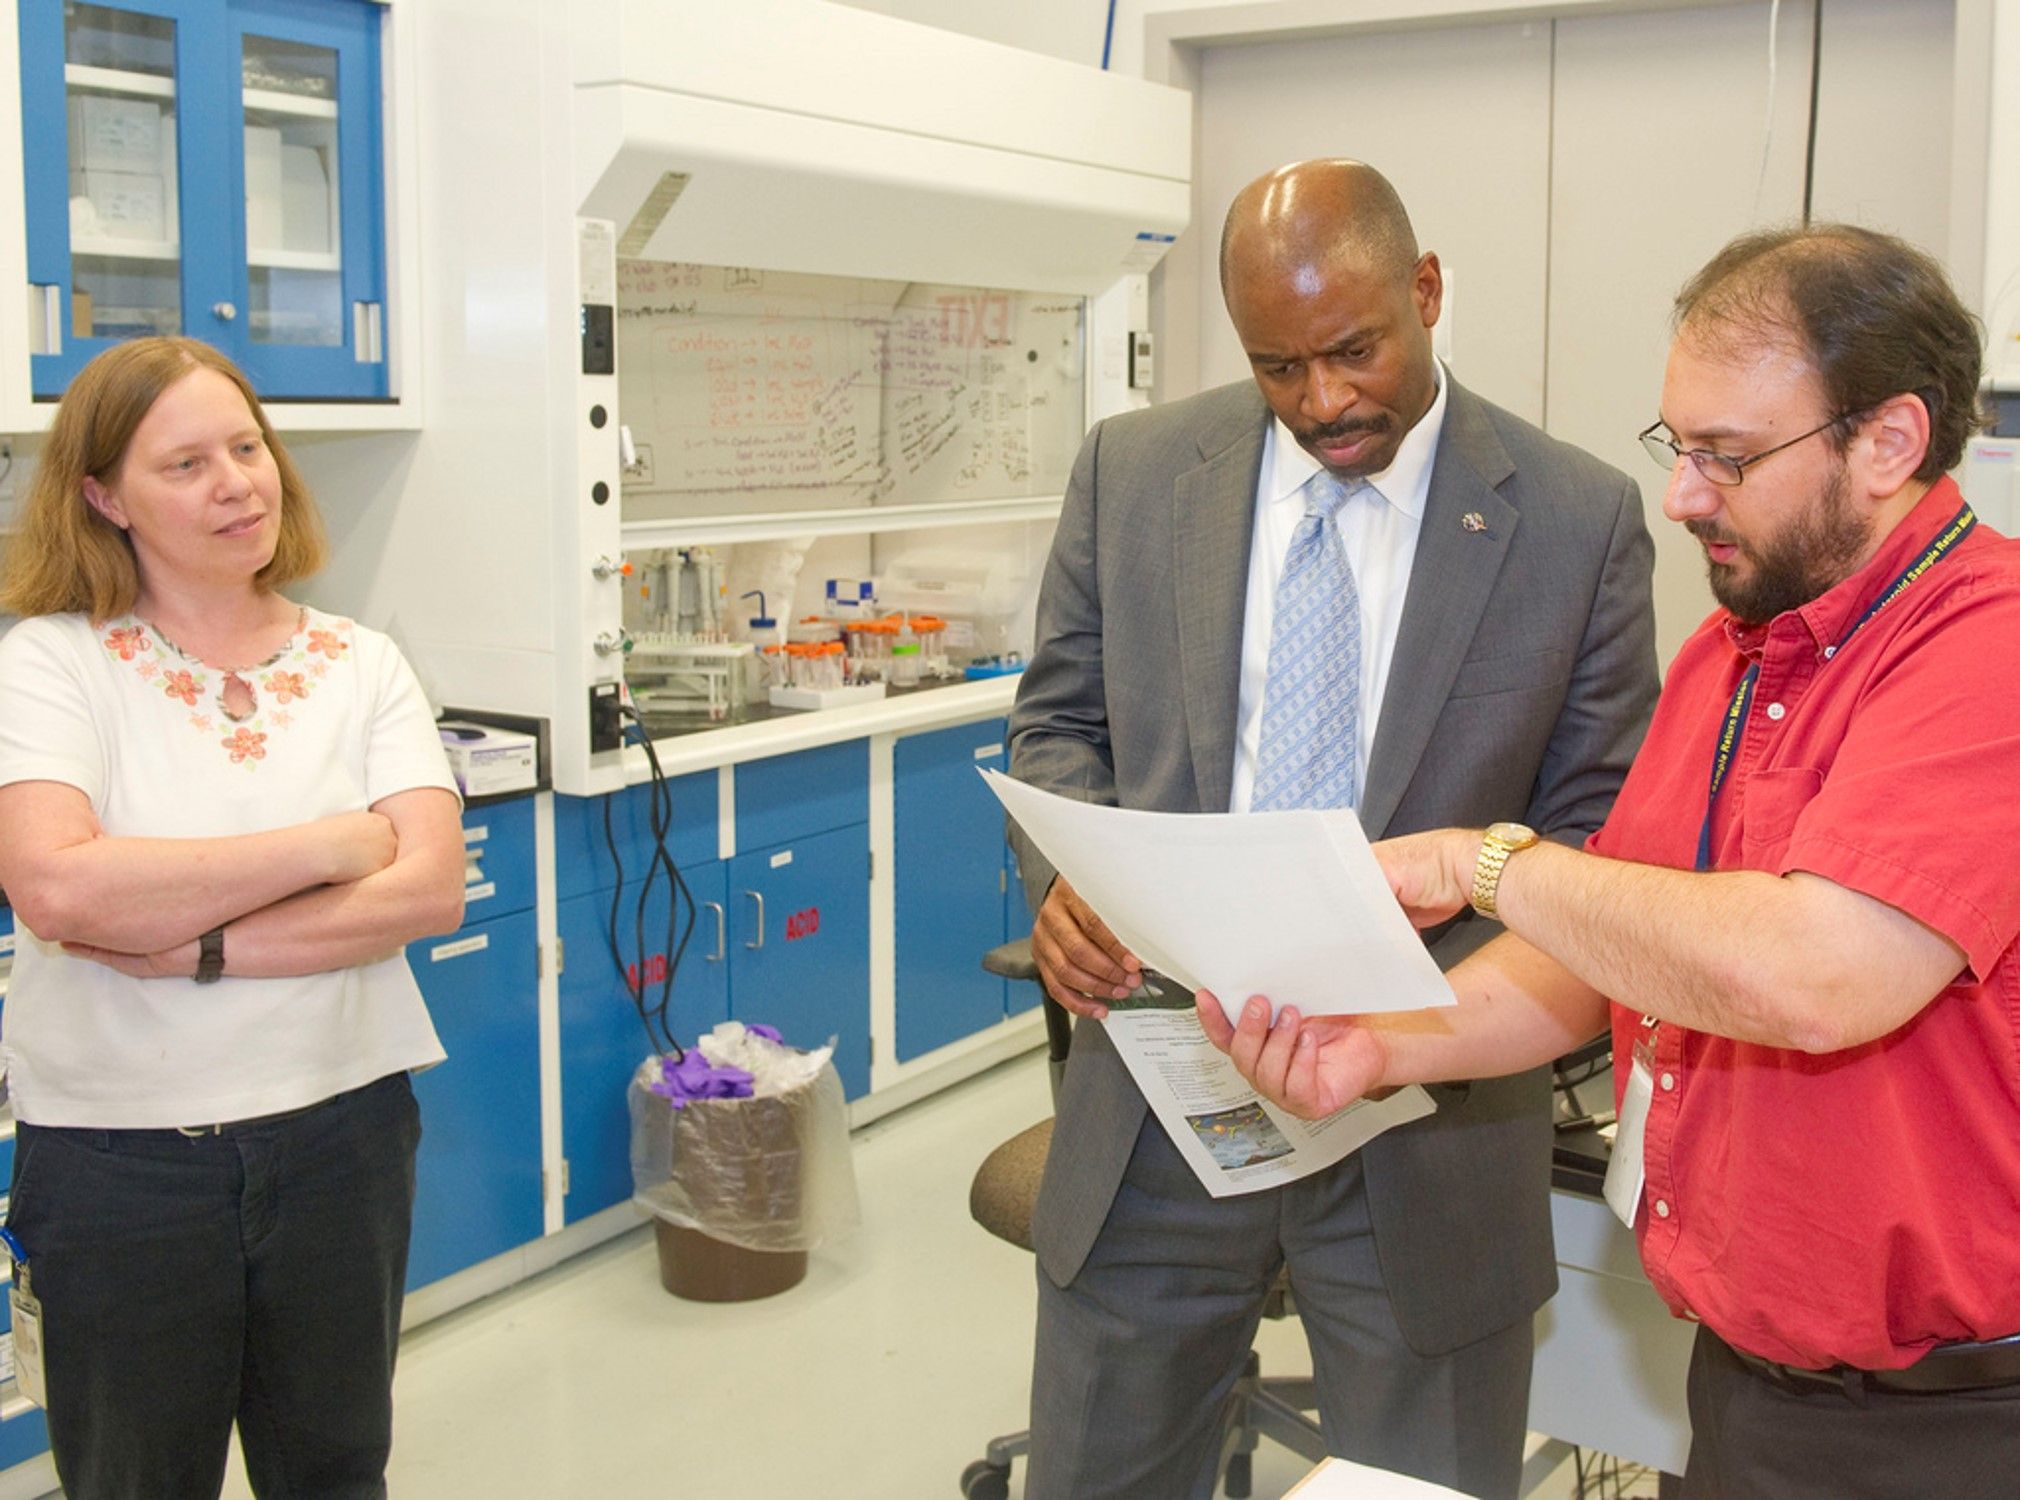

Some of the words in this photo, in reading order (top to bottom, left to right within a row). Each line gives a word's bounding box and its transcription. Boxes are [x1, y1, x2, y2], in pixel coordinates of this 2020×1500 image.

[1907, 549, 1941, 582] Sample
[1935, 525, 1961, 552] Return
[1720, 719, 1737, 753] Return
[1730, 680, 1748, 717] Mission
[786, 907, 819, 939] ACID
[627, 954, 667, 990] ACID
